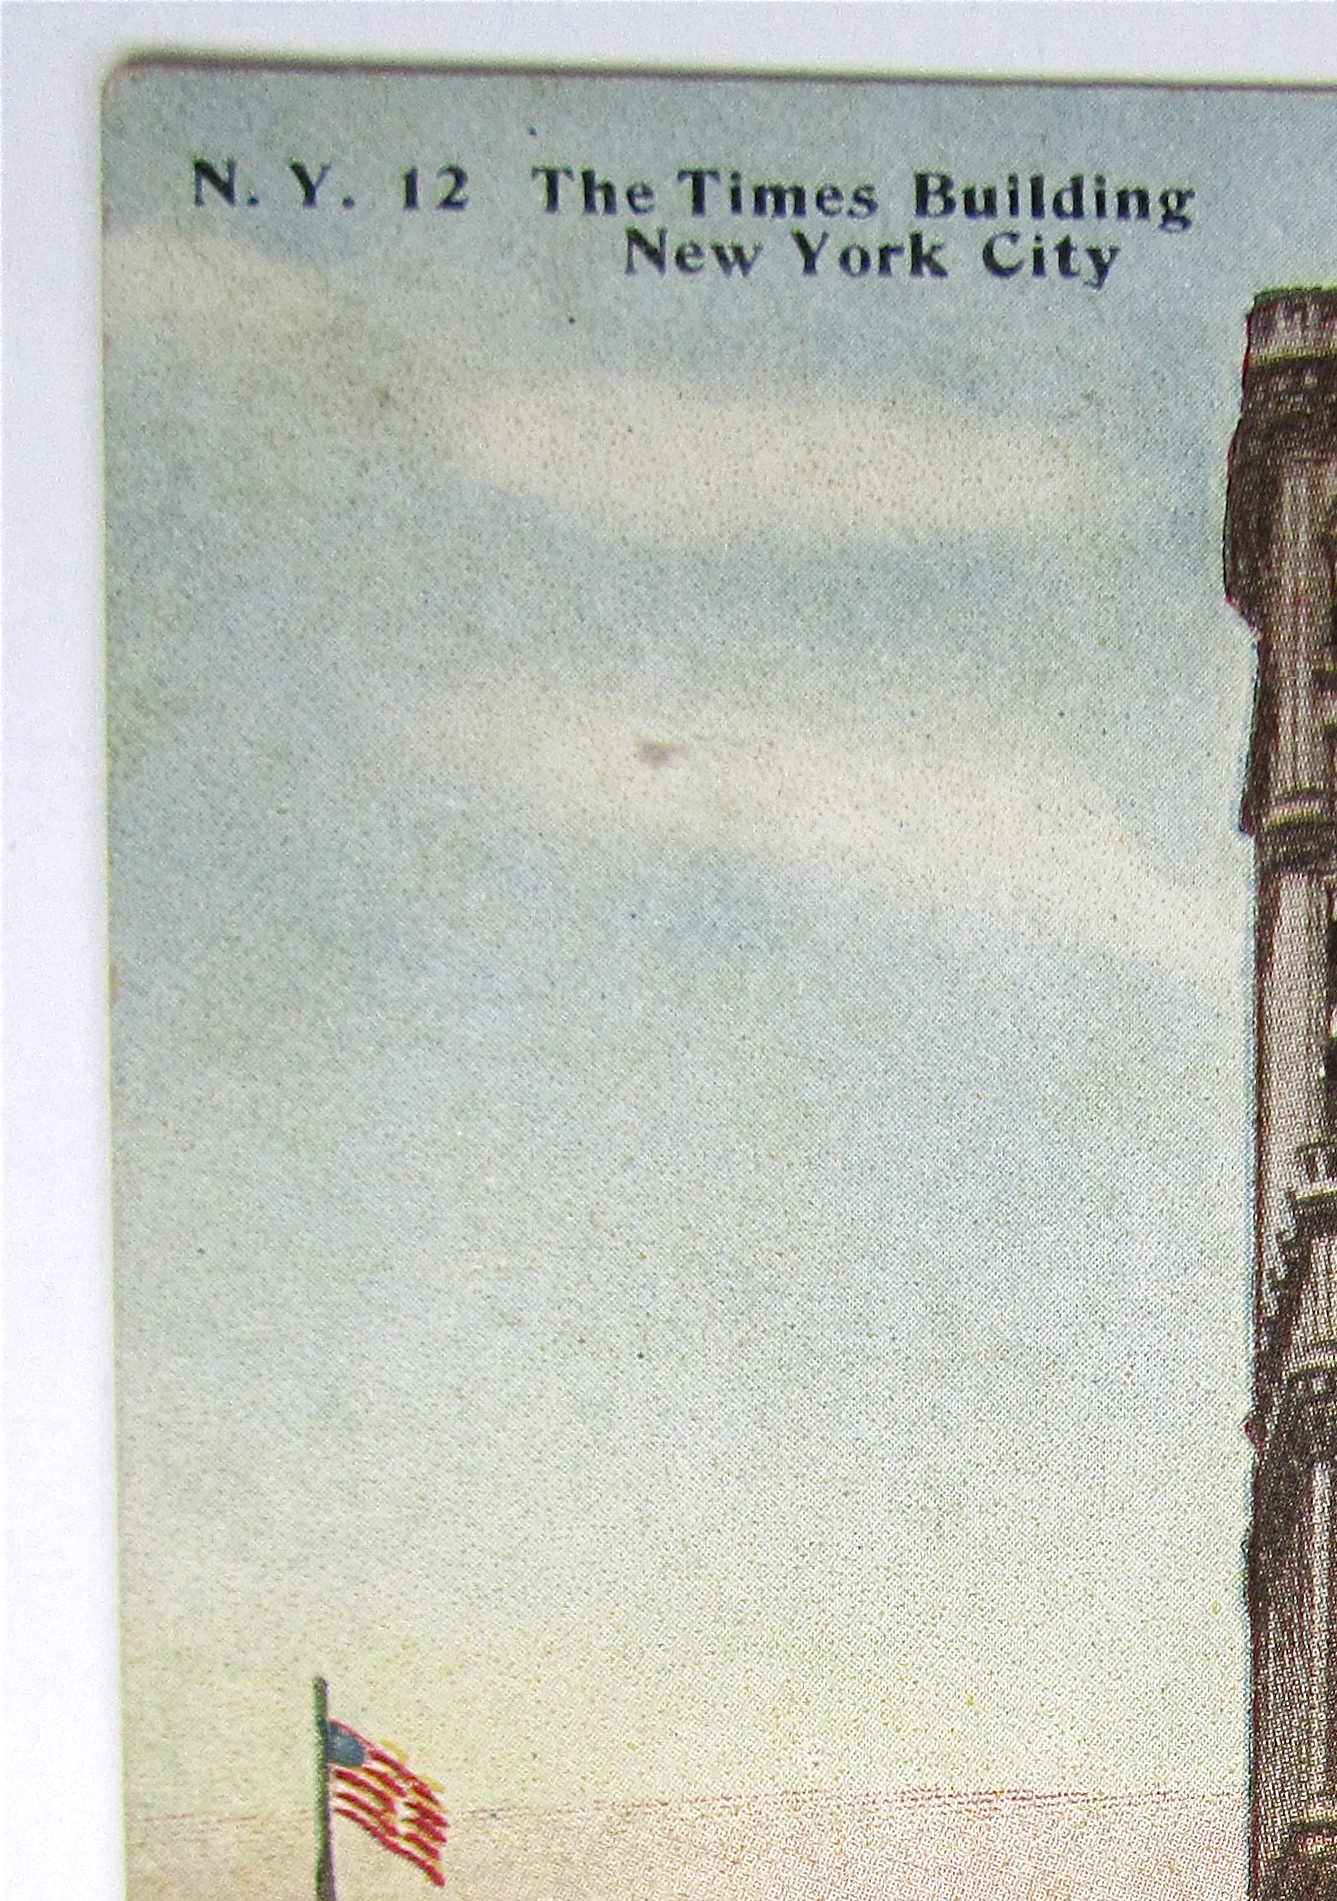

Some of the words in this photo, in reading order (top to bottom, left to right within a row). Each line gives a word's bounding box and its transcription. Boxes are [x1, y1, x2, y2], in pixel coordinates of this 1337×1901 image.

[192, 158, 260, 206] N.
[288, 162, 354, 207] Y.
[402, 165, 468, 210] 12
[530, 166, 654, 215] The
[676, 168, 879, 218] Times
[913, 172, 1196, 231] Building
[625, 228, 763, 276] New
[790, 231, 949, 278] York
[981, 231, 1121, 290] City
